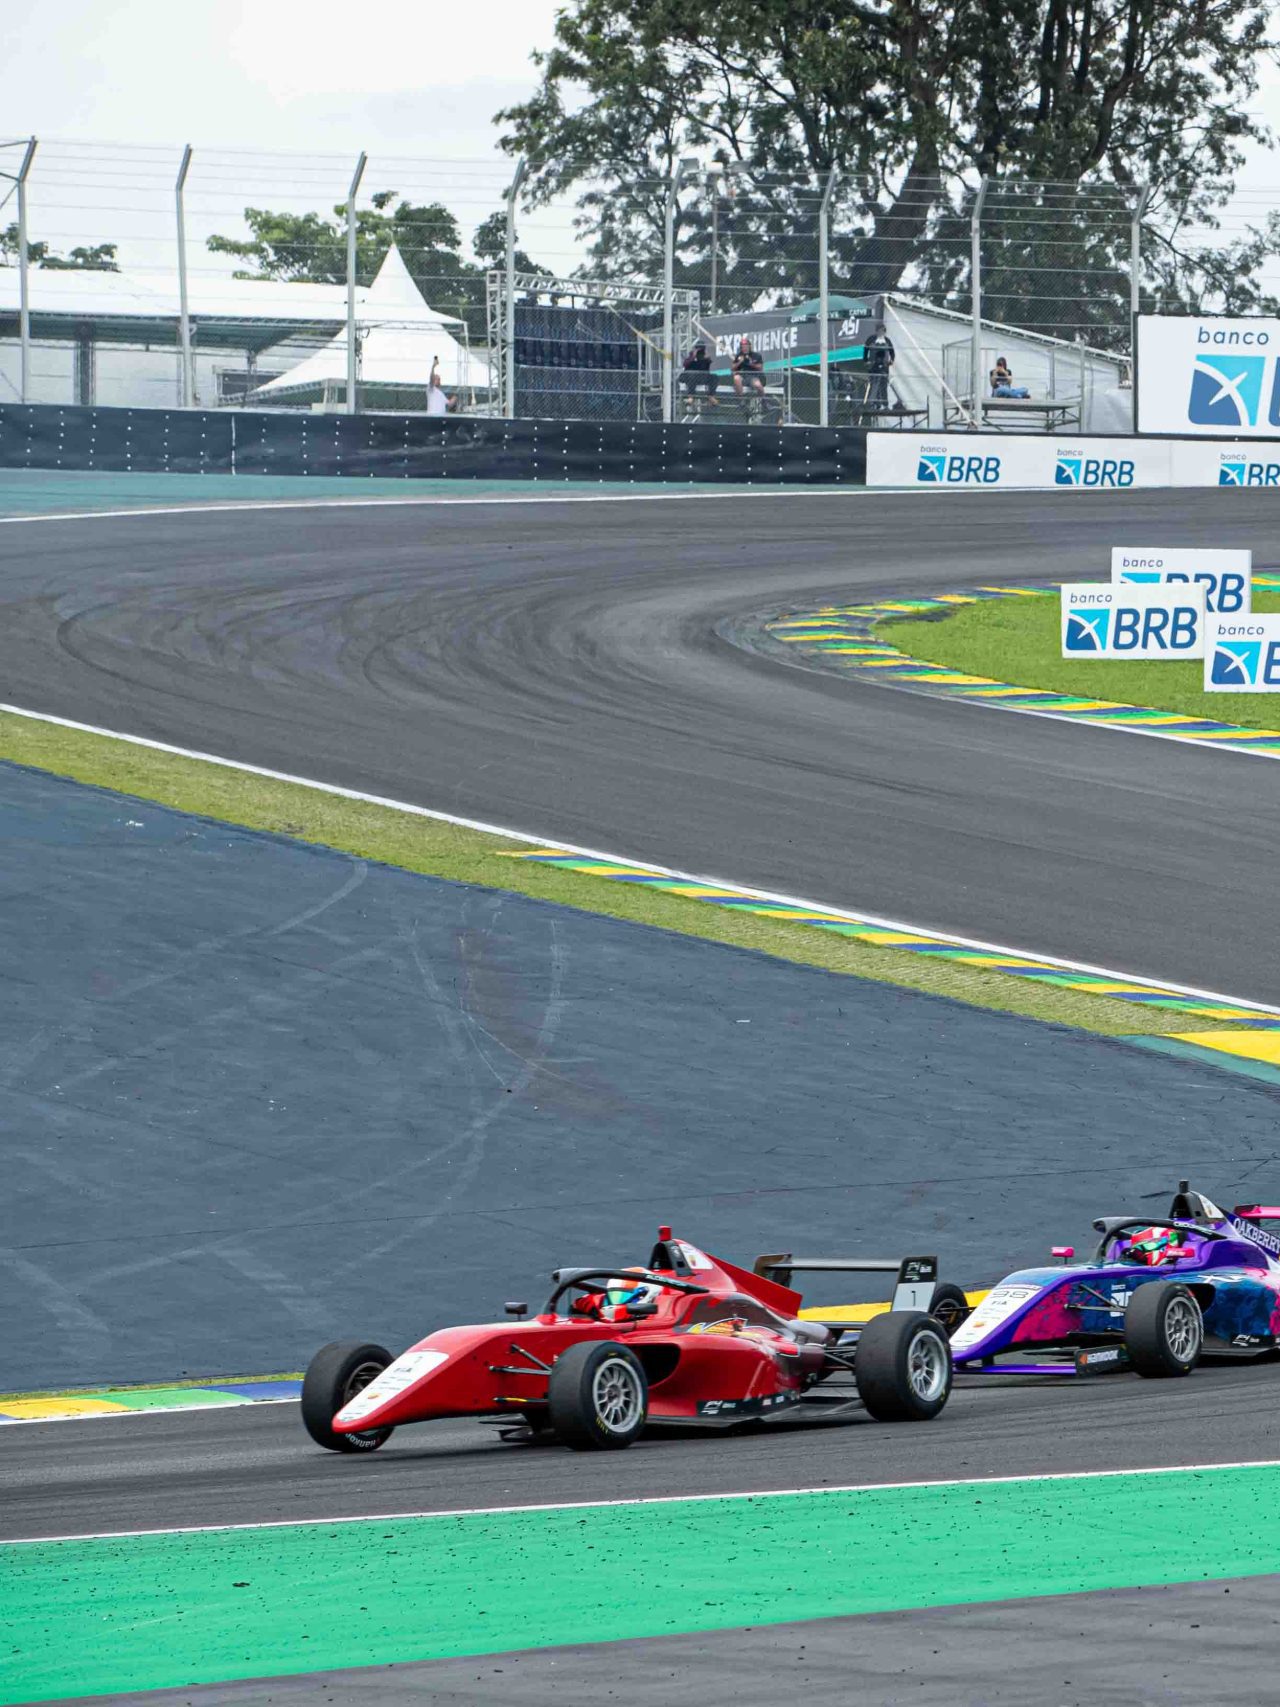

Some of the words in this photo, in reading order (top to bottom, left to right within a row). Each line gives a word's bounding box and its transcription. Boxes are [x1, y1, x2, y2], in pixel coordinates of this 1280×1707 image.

[1197, 326, 1270, 346] banco
[1220, 453, 1247, 461] banco
[947, 456, 1000, 483] BRB
[1083, 460, 1134, 486] BRB
[1122, 557, 1164, 568] banco
[1070, 592, 1113, 603] banco
[1112, 606, 1197, 651] BRB
[1217, 624, 1265, 636] banco
